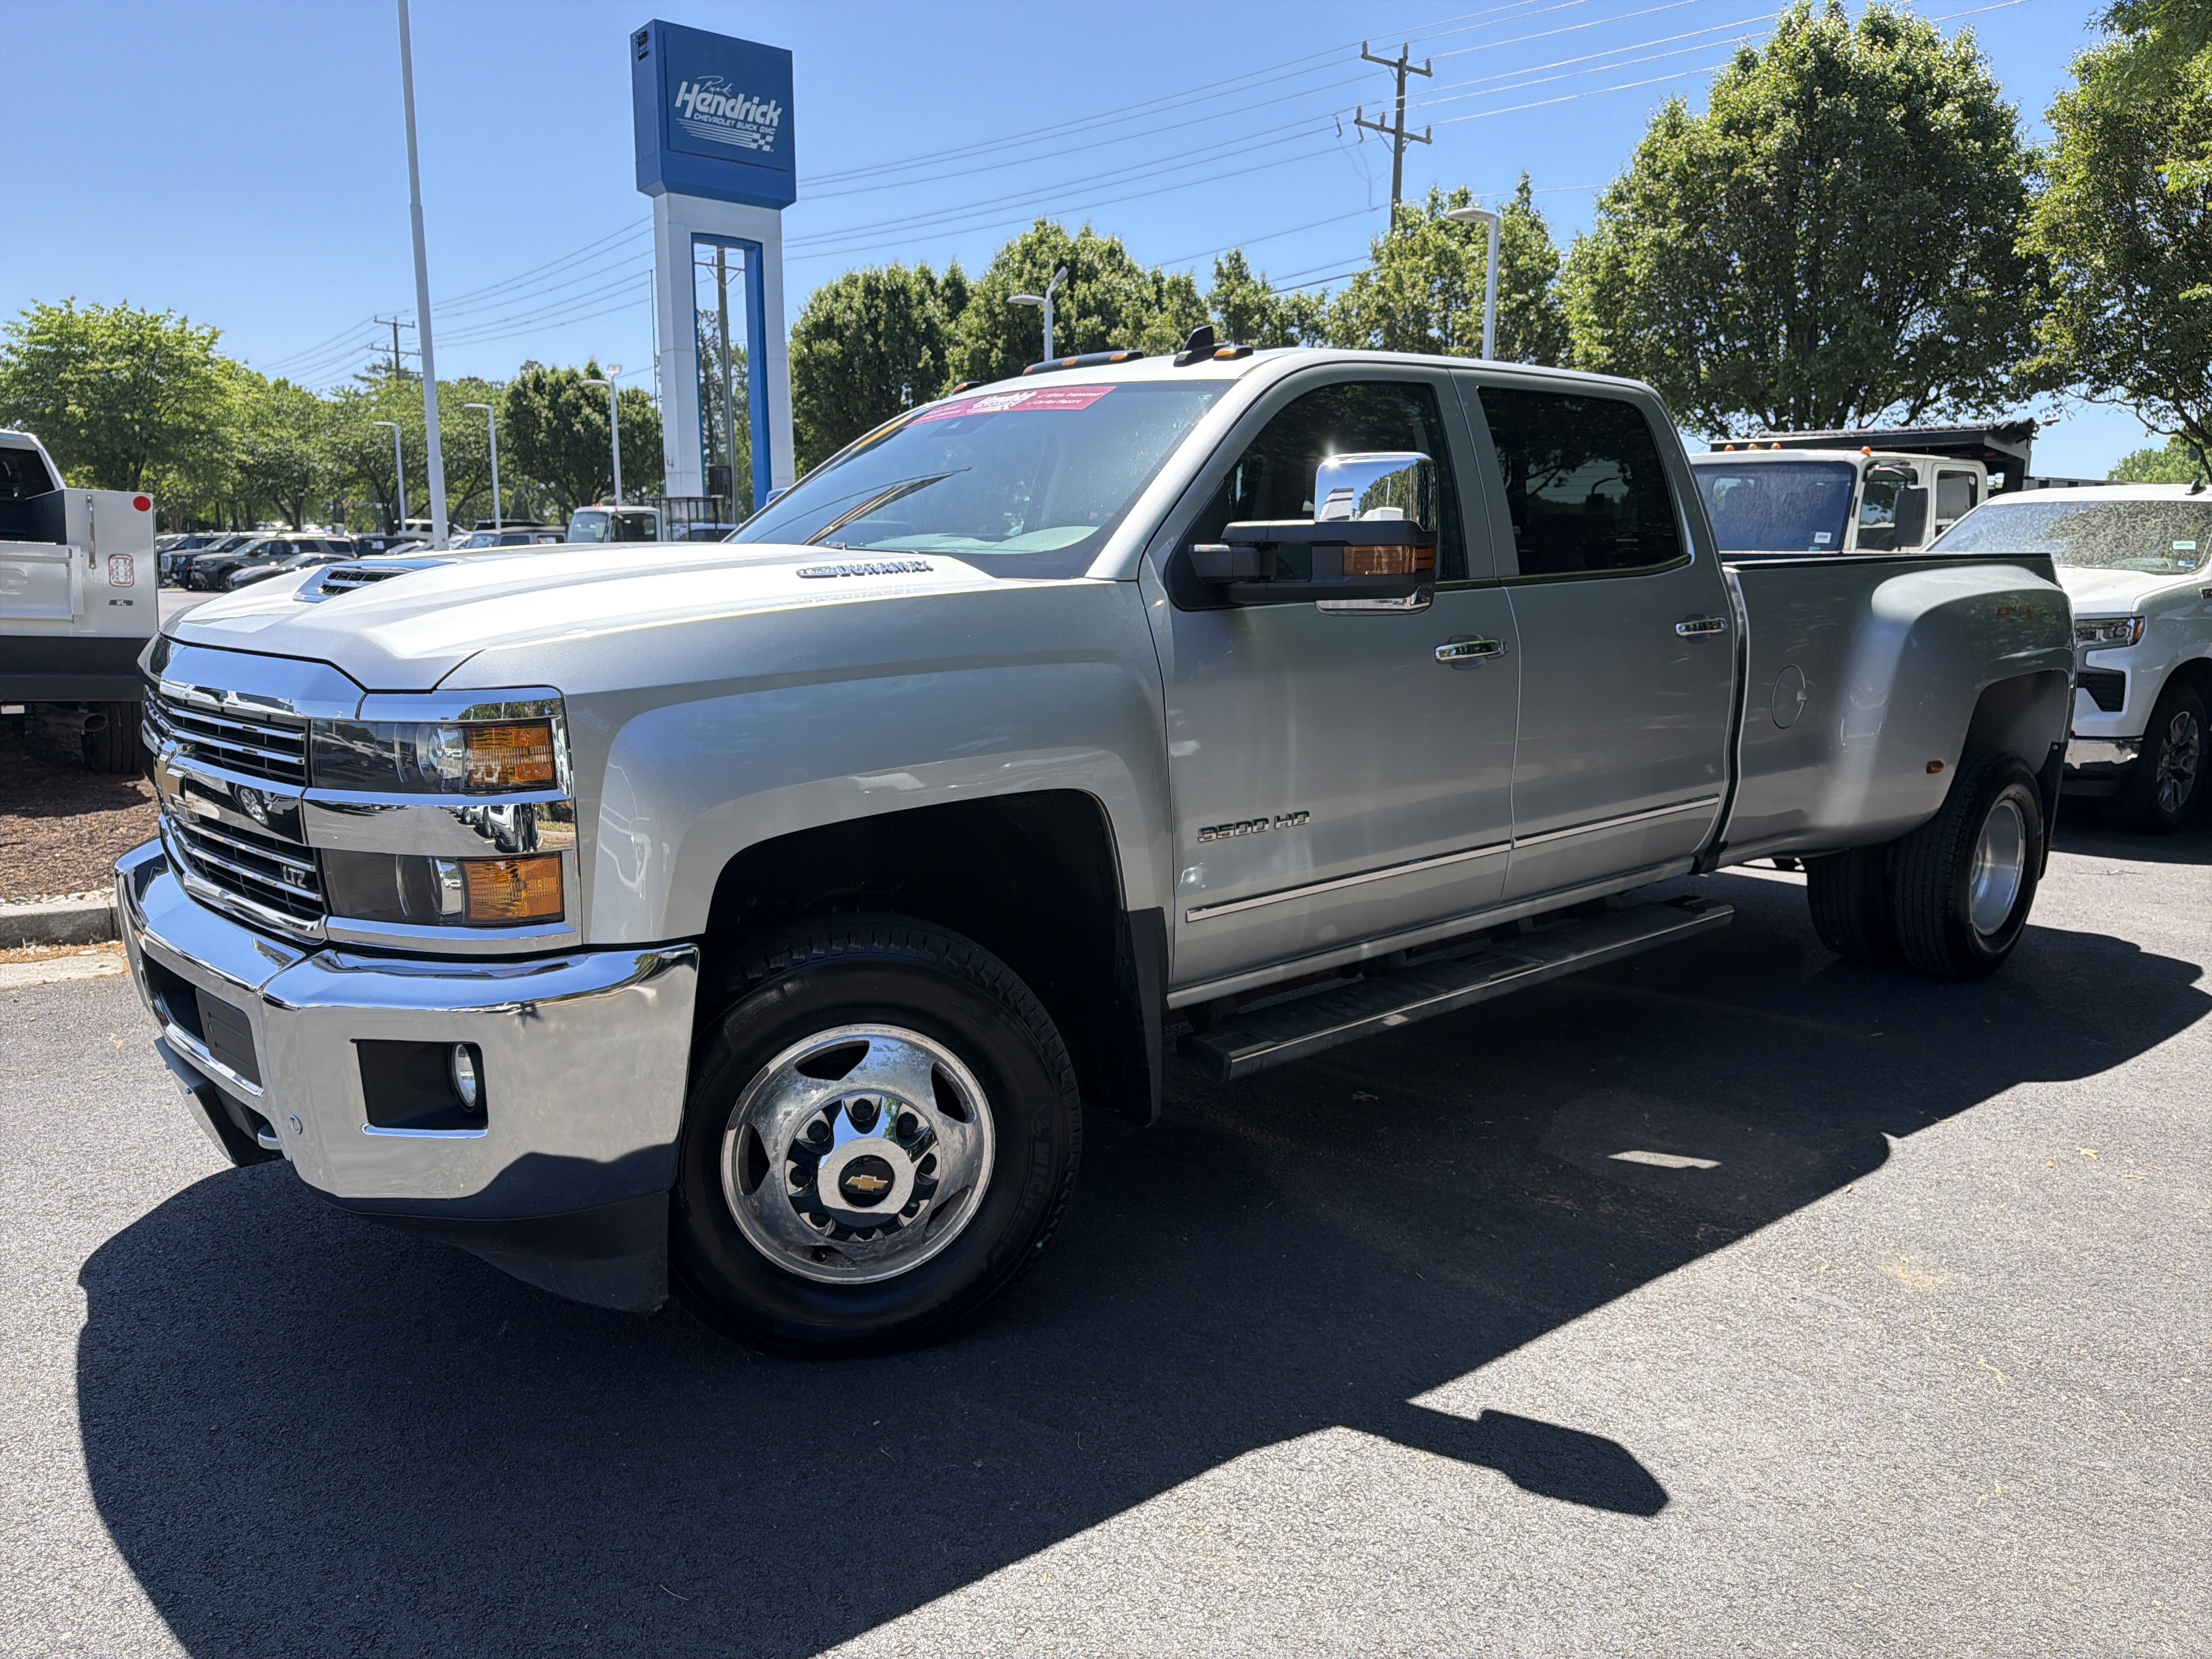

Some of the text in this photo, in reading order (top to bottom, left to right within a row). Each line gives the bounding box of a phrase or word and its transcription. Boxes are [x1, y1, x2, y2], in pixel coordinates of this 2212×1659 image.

[674, 81, 782, 126] Hendrick
[693, 112, 776, 135] CHEVROLET BUICK GMC
[1997, 606, 2034, 620] 44
[1198, 810, 1311, 843] 3500 HD
[283, 865, 307, 888] LTZ
